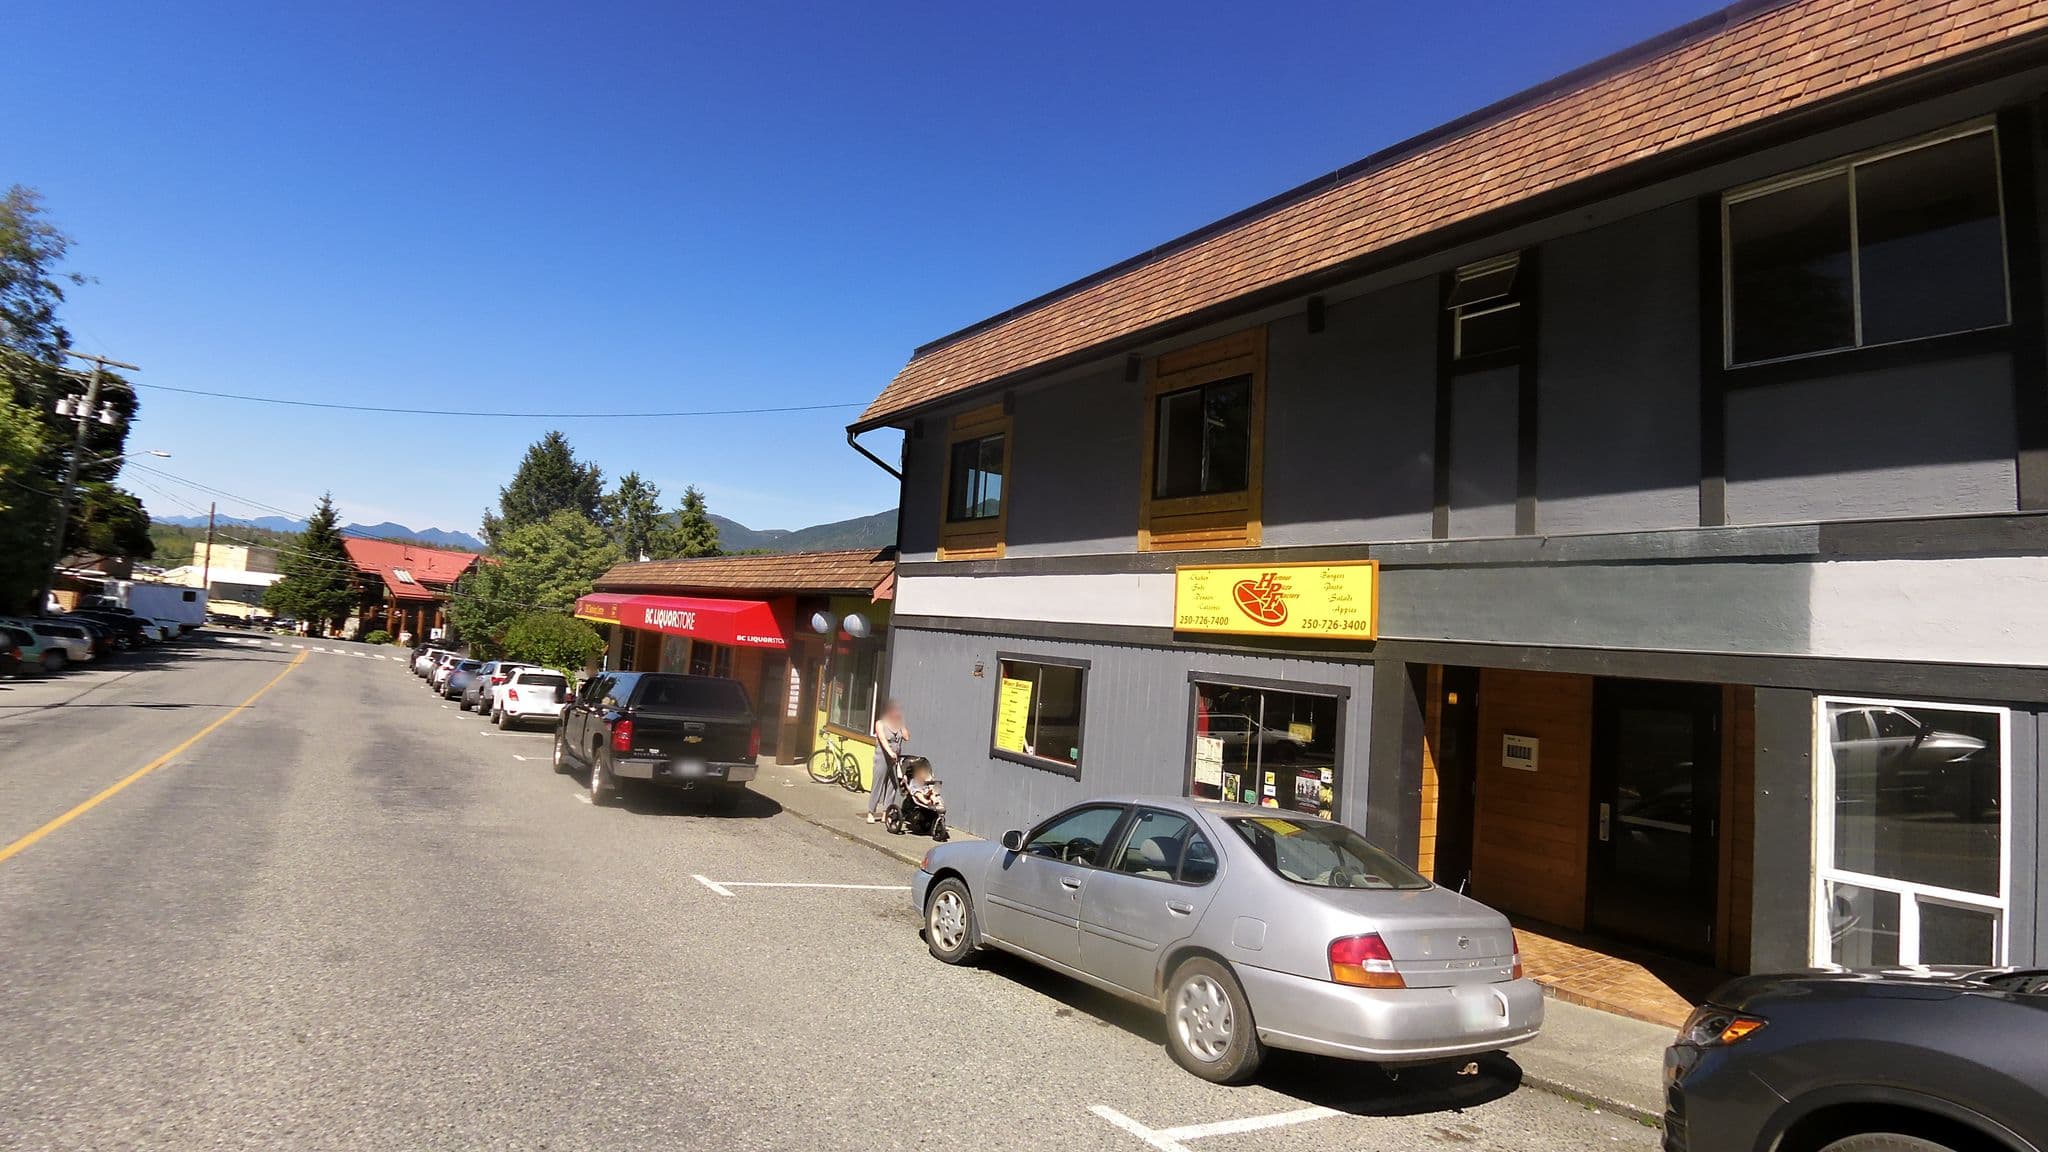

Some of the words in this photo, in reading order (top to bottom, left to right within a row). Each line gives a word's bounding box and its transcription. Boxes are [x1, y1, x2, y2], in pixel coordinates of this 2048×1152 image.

[645, 608, 654, 624] BC
[1179, 615, 1229, 626] 250-726-7400
[1301, 618, 1367, 631] 250-726-3400
